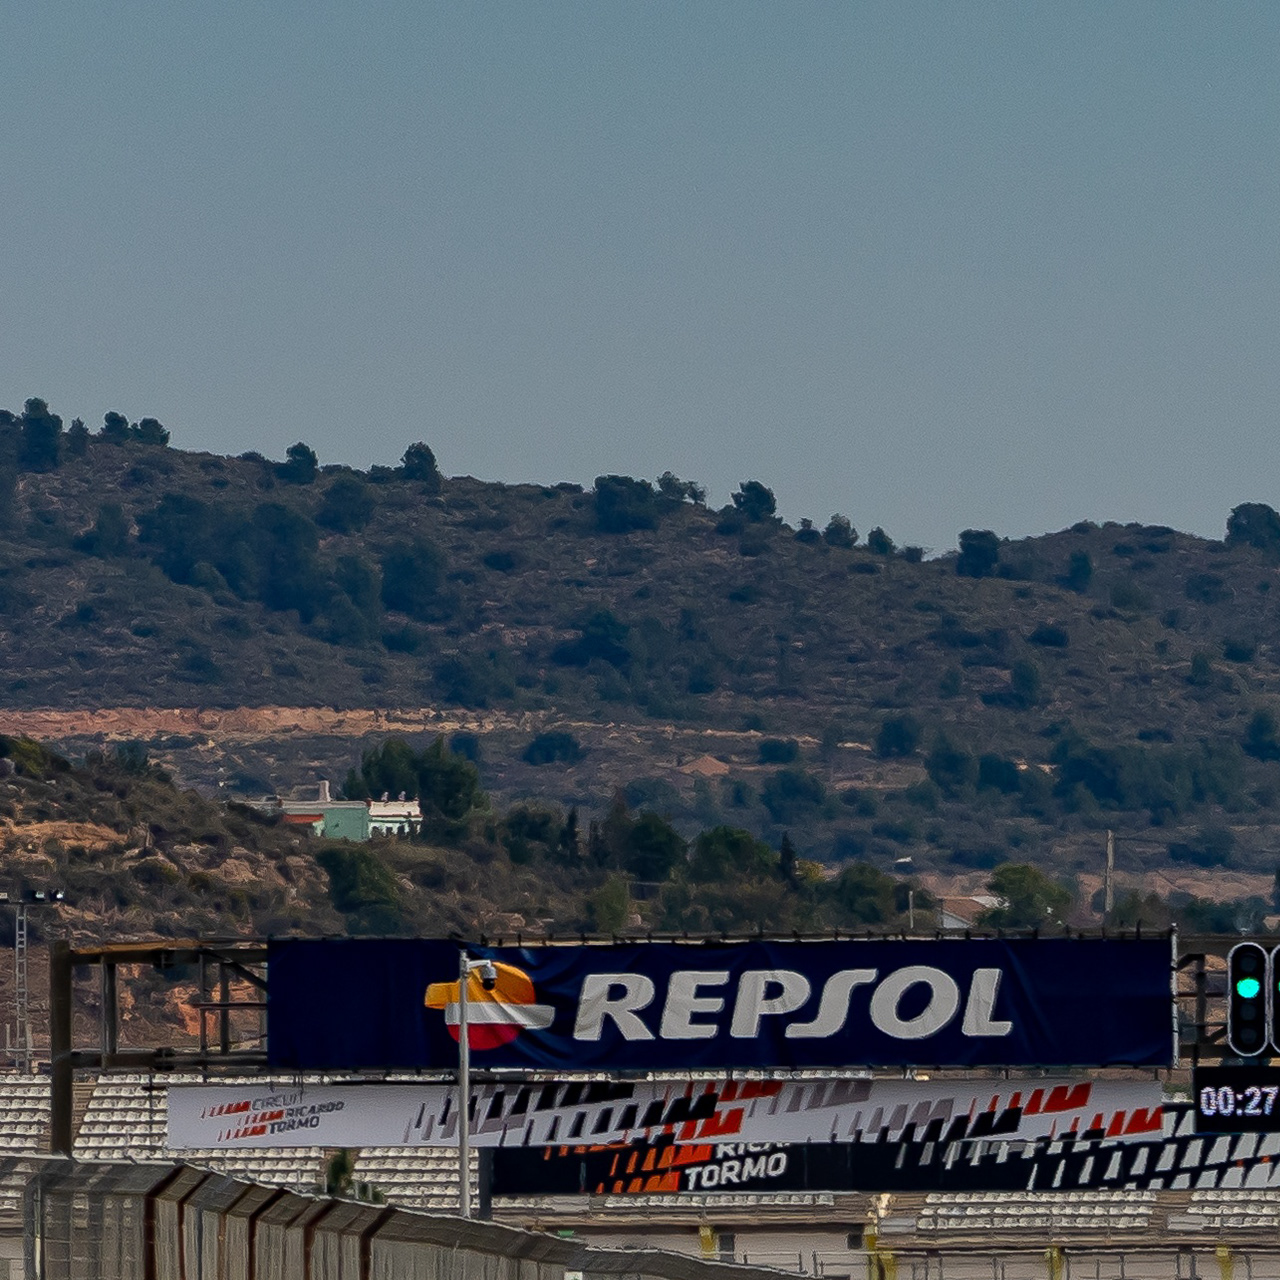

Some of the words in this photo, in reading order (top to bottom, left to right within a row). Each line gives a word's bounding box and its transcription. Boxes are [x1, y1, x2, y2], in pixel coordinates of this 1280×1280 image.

[573, 965, 1013, 1041] REPSOL
[285, 1101, 345, 1118] RICARDO
[269, 1115, 320, 1134] TORMO
[685, 1152, 787, 1190] TORMO
